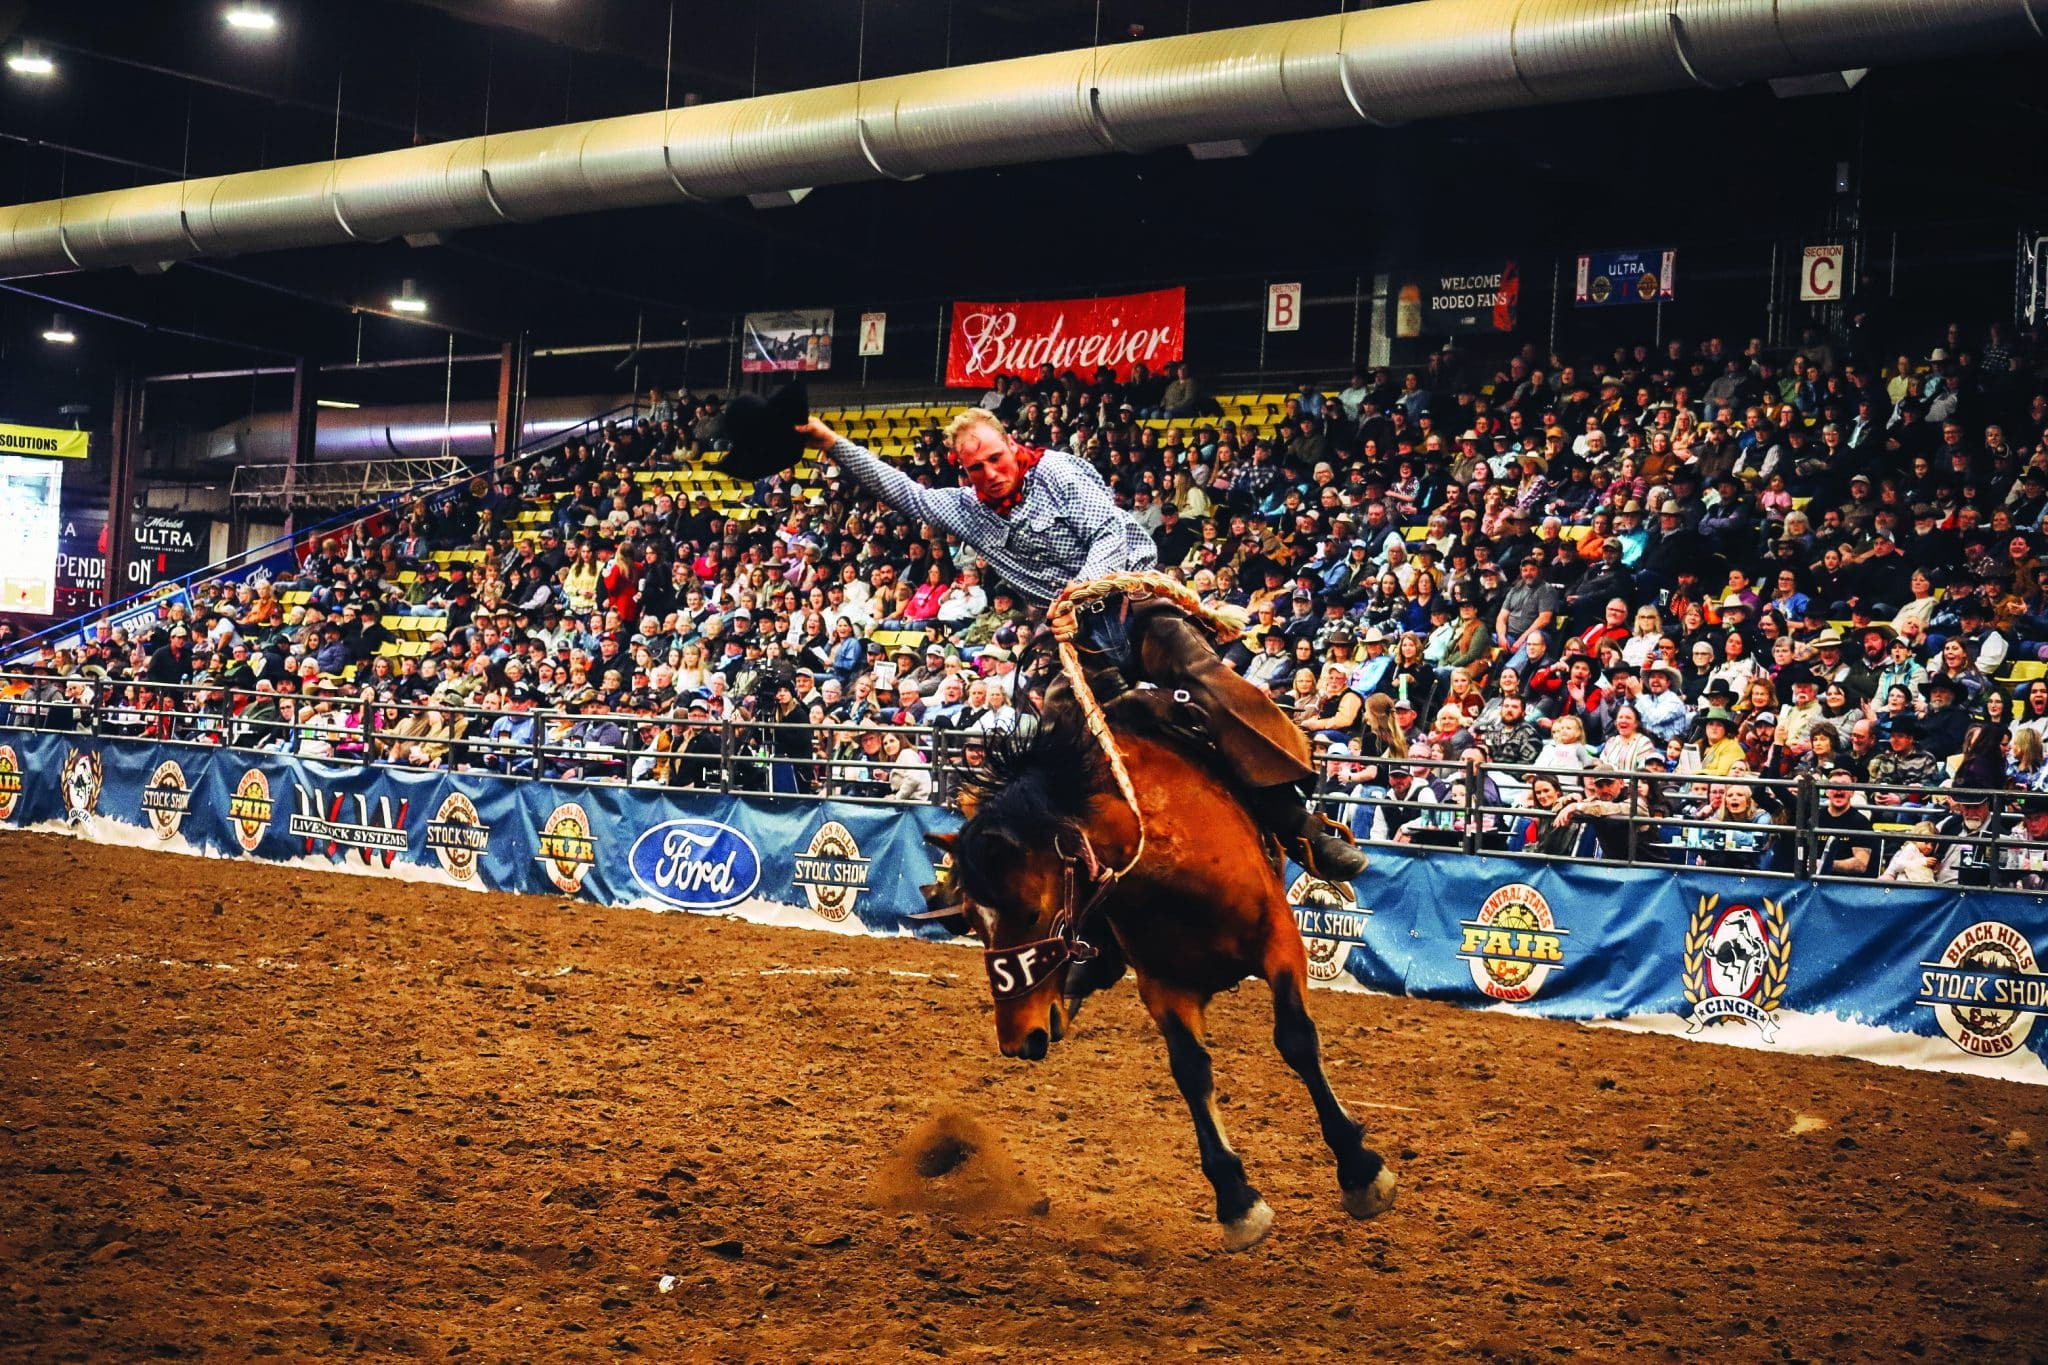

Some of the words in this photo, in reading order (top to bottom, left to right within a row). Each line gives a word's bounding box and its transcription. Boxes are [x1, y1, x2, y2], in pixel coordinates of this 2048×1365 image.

[1804, 247, 1842, 257] SECTION
[1608, 262, 1645, 276] ULTRA
[1809, 257, 1834, 295] C
[1441, 274, 1502, 291] WELCOME
[1275, 294, 1293, 326] B
[1432, 295, 1474, 310] RODEO
[1477, 293, 1507, 308] FANS
[863, 322, 879, 351] A
[963, 312, 1170, 377] Budweiser
[0, 434, 58, 451] SOLUTIONS
[135, 528, 194, 547] ULTRA
[122, 611, 157, 632] BUD
[143, 791, 170, 808] STOCK
[171, 794, 191, 810] SHOW
[230, 799, 272, 821] FAIR
[353, 829, 407, 847] SYSTEMS
[427, 826, 461, 846] STOCK
[811, 823, 834, 854] BLACK
[834, 825, 857, 857] HILLS
[538, 837, 595, 860] FAIR
[655, 829, 737, 895] Ford
[795, 859, 831, 881] STOCK
[834, 863, 869, 884] SHOW
[817, 904, 846, 920] RODEO
[1480, 885, 1522, 924] CENTRAL
[1522, 886, 1553, 930] STATES
[1294, 910, 1322, 933] OCK
[1324, 914, 1369, 938] SHOW
[1459, 927, 1564, 962] FAIR
[1946, 925, 1994, 965] BLACK
[1996, 926, 2034, 970] HILLS
[1307, 959, 1338, 978] ODEO
[1484, 981, 1531, 999] RODEO
[1920, 971, 1989, 1003] STOCK
[1704, 1000, 1760, 1023] CINCH
[1958, 1029, 2013, 1055] RODEO
